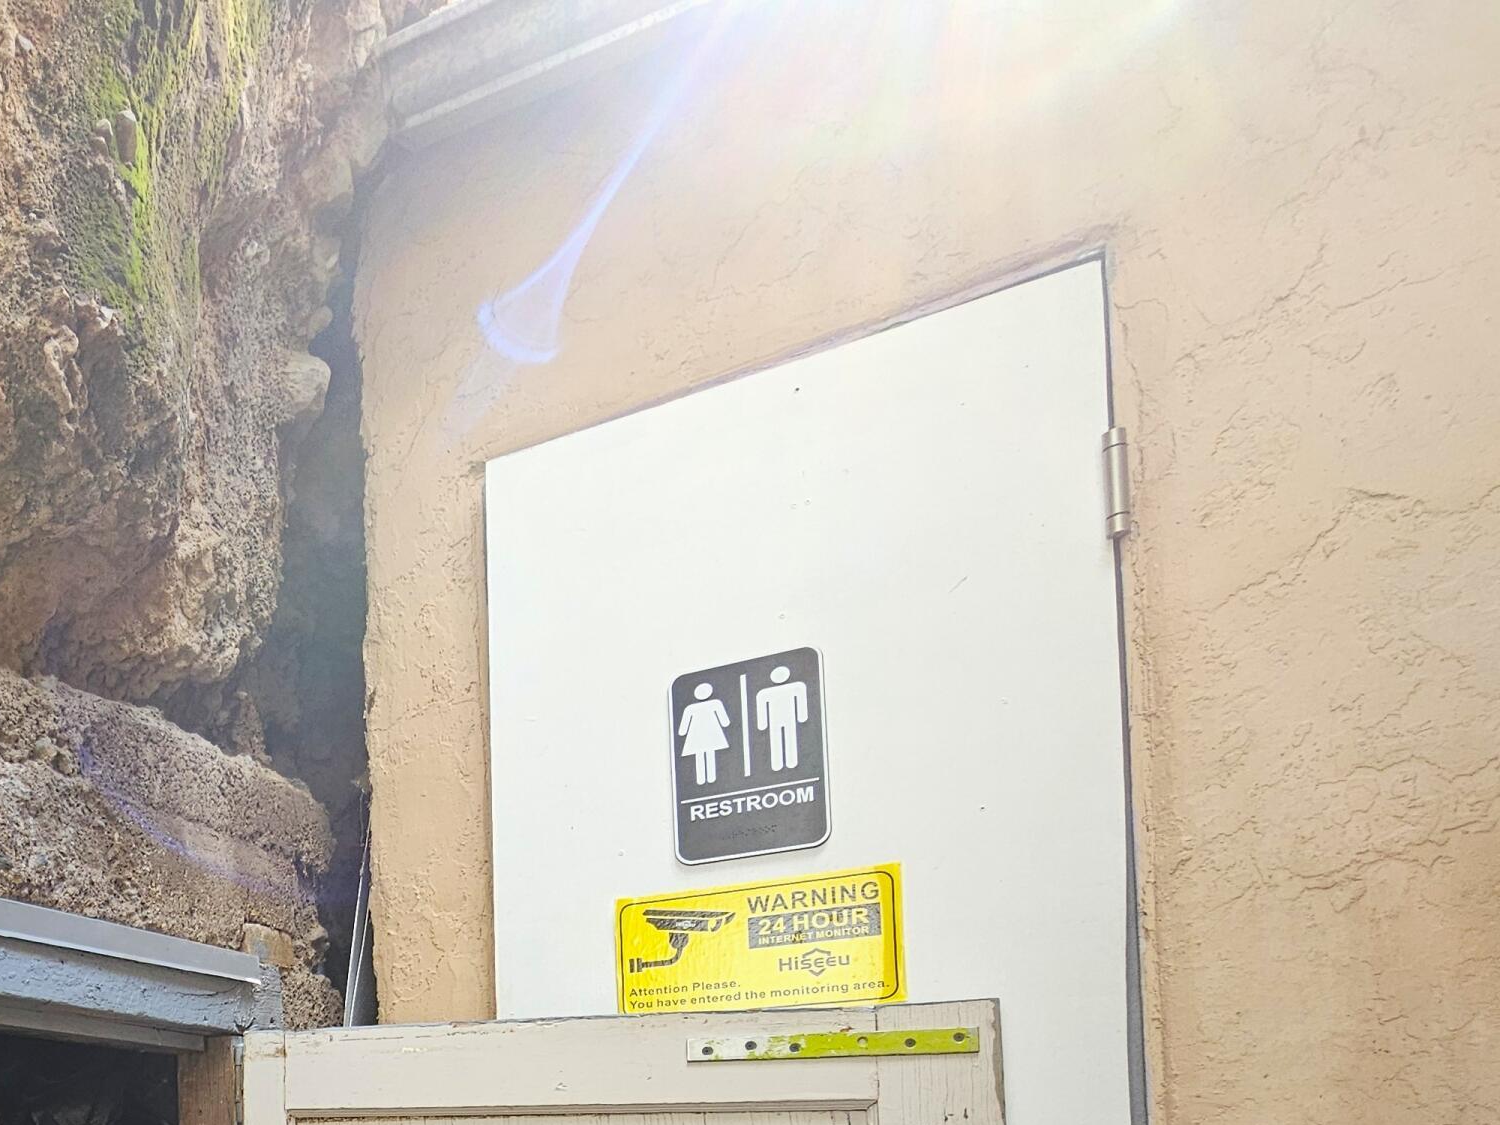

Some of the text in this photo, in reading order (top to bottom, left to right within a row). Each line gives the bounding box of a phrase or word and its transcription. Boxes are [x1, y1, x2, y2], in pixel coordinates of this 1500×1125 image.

[690, 785, 815, 822] RESTROOM
[747, 881, 879, 914] WARNING
[758, 907, 870, 936] 24 HOUR
[758, 926, 870, 945] INTERNET MONITOR
[629, 980, 741, 998] Attention Please.
[630, 980, 890, 1010] You have entered the monitoring area.
